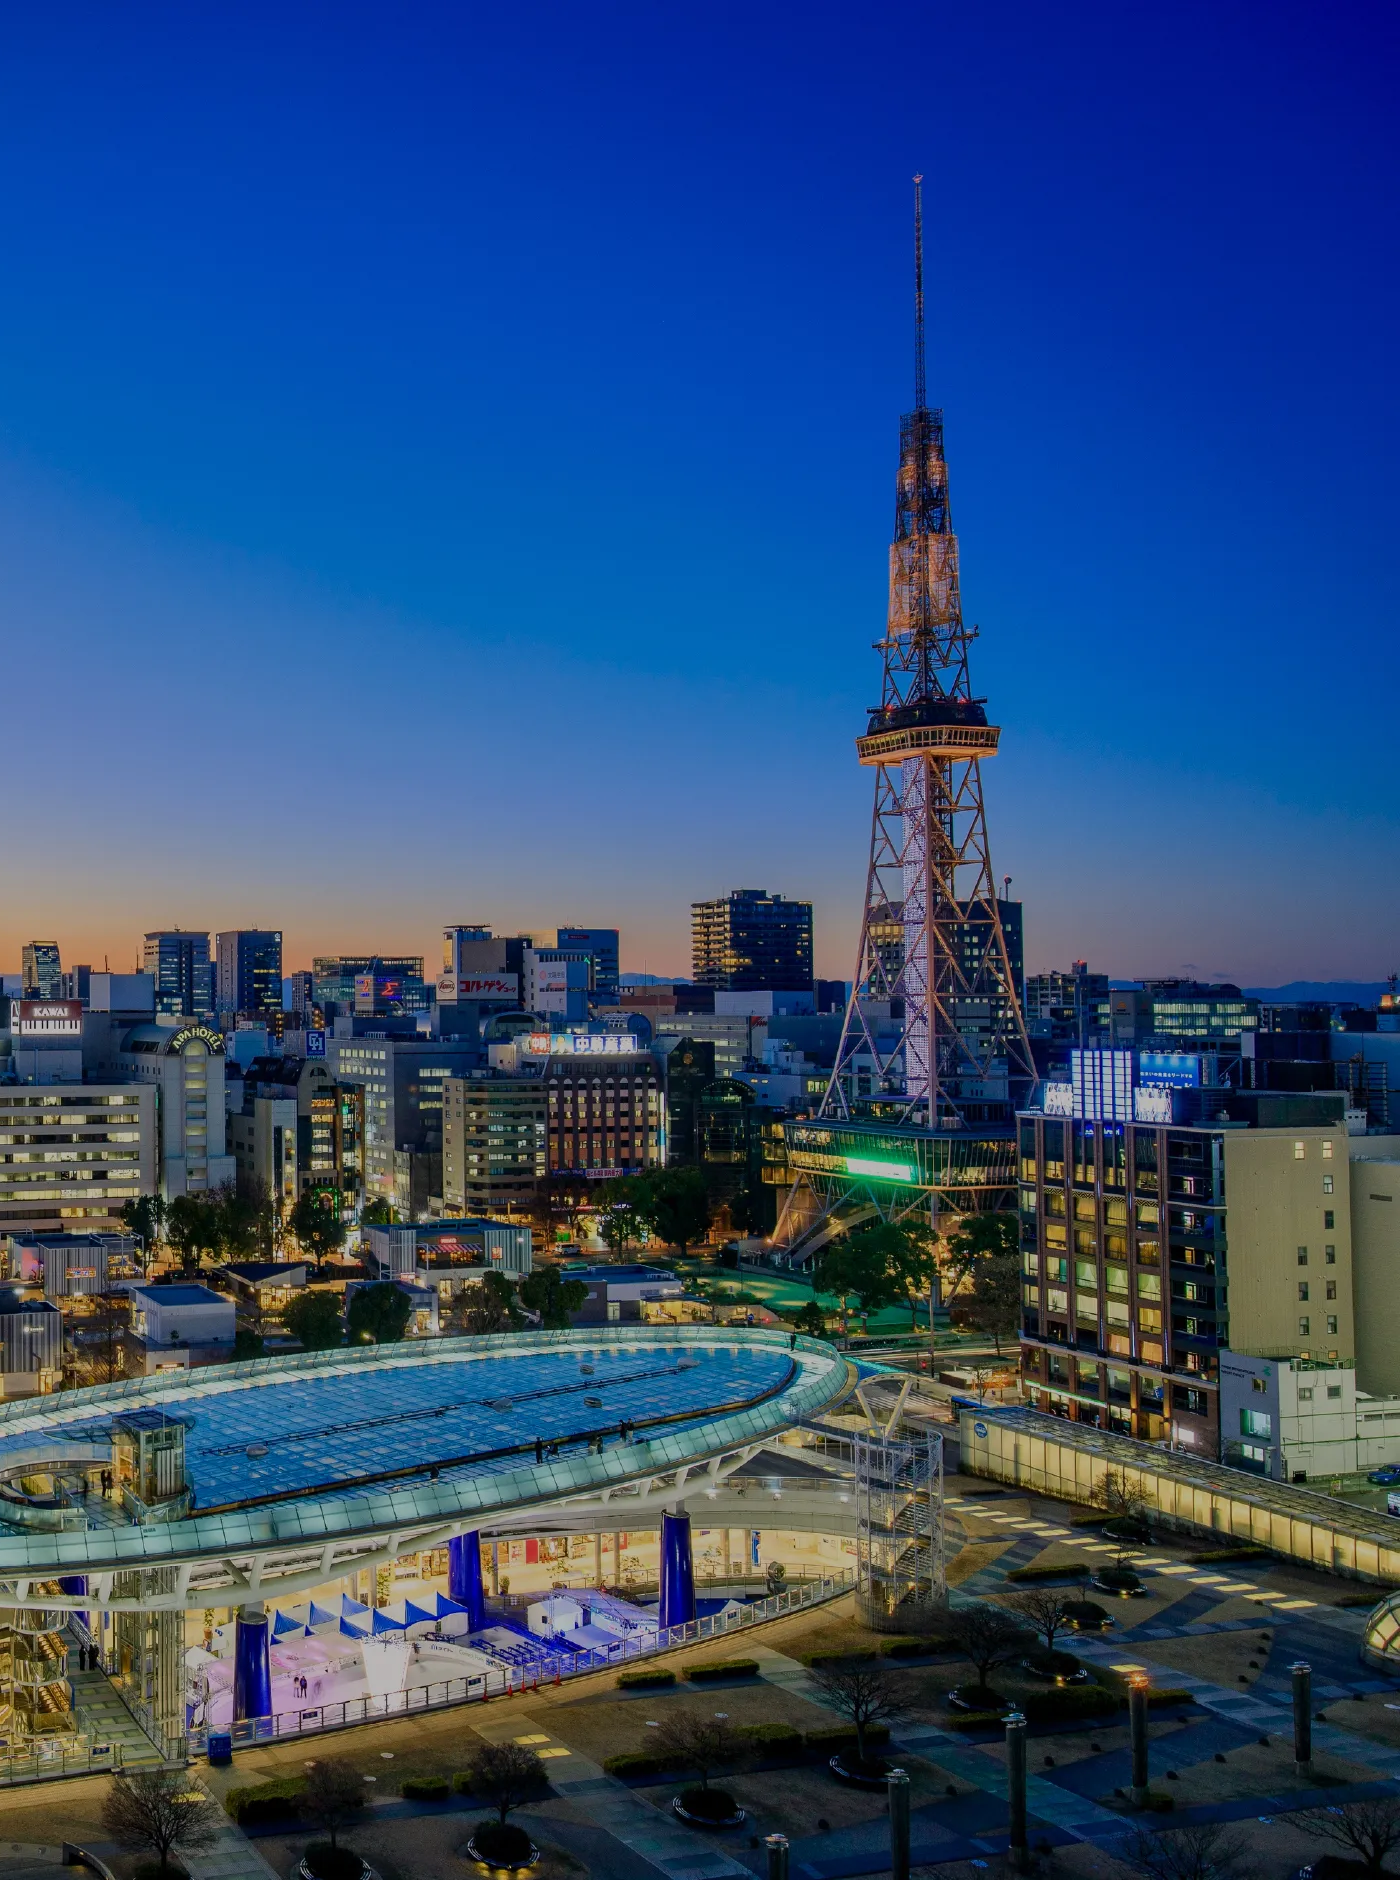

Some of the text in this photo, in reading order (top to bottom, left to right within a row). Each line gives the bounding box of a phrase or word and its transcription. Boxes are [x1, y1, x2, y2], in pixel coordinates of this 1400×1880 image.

[33, 1007, 69, 1017] KAWAI
[172, 1027, 221, 1050] APA HOTEL
